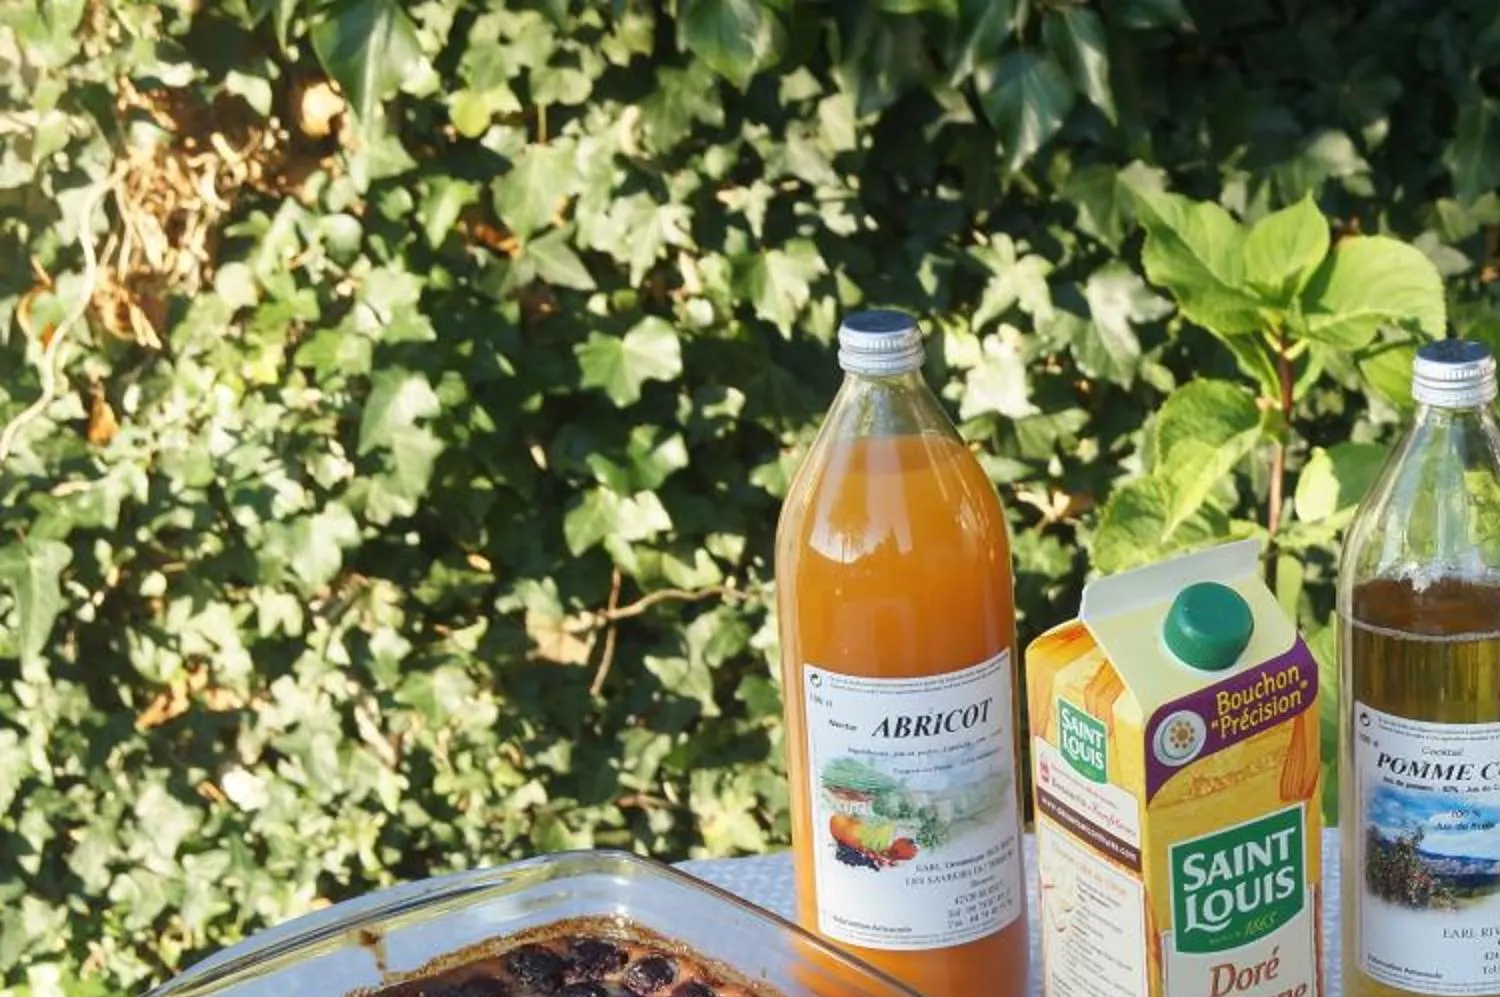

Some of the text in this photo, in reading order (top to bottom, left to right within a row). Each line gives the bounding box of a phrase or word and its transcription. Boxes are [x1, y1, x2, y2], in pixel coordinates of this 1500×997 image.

[1215, 665, 1300, 717] Bouchon
[872, 697, 993, 739] ABRICOT
[1061, 707, 1104, 749] SAINT
[1062, 729, 1105, 772] LOUIS
[1377, 750, 1475, 782] POMME
[1183, 826, 1296, 893] SAINT
[1184, 865, 1296, 934] LOUIS
